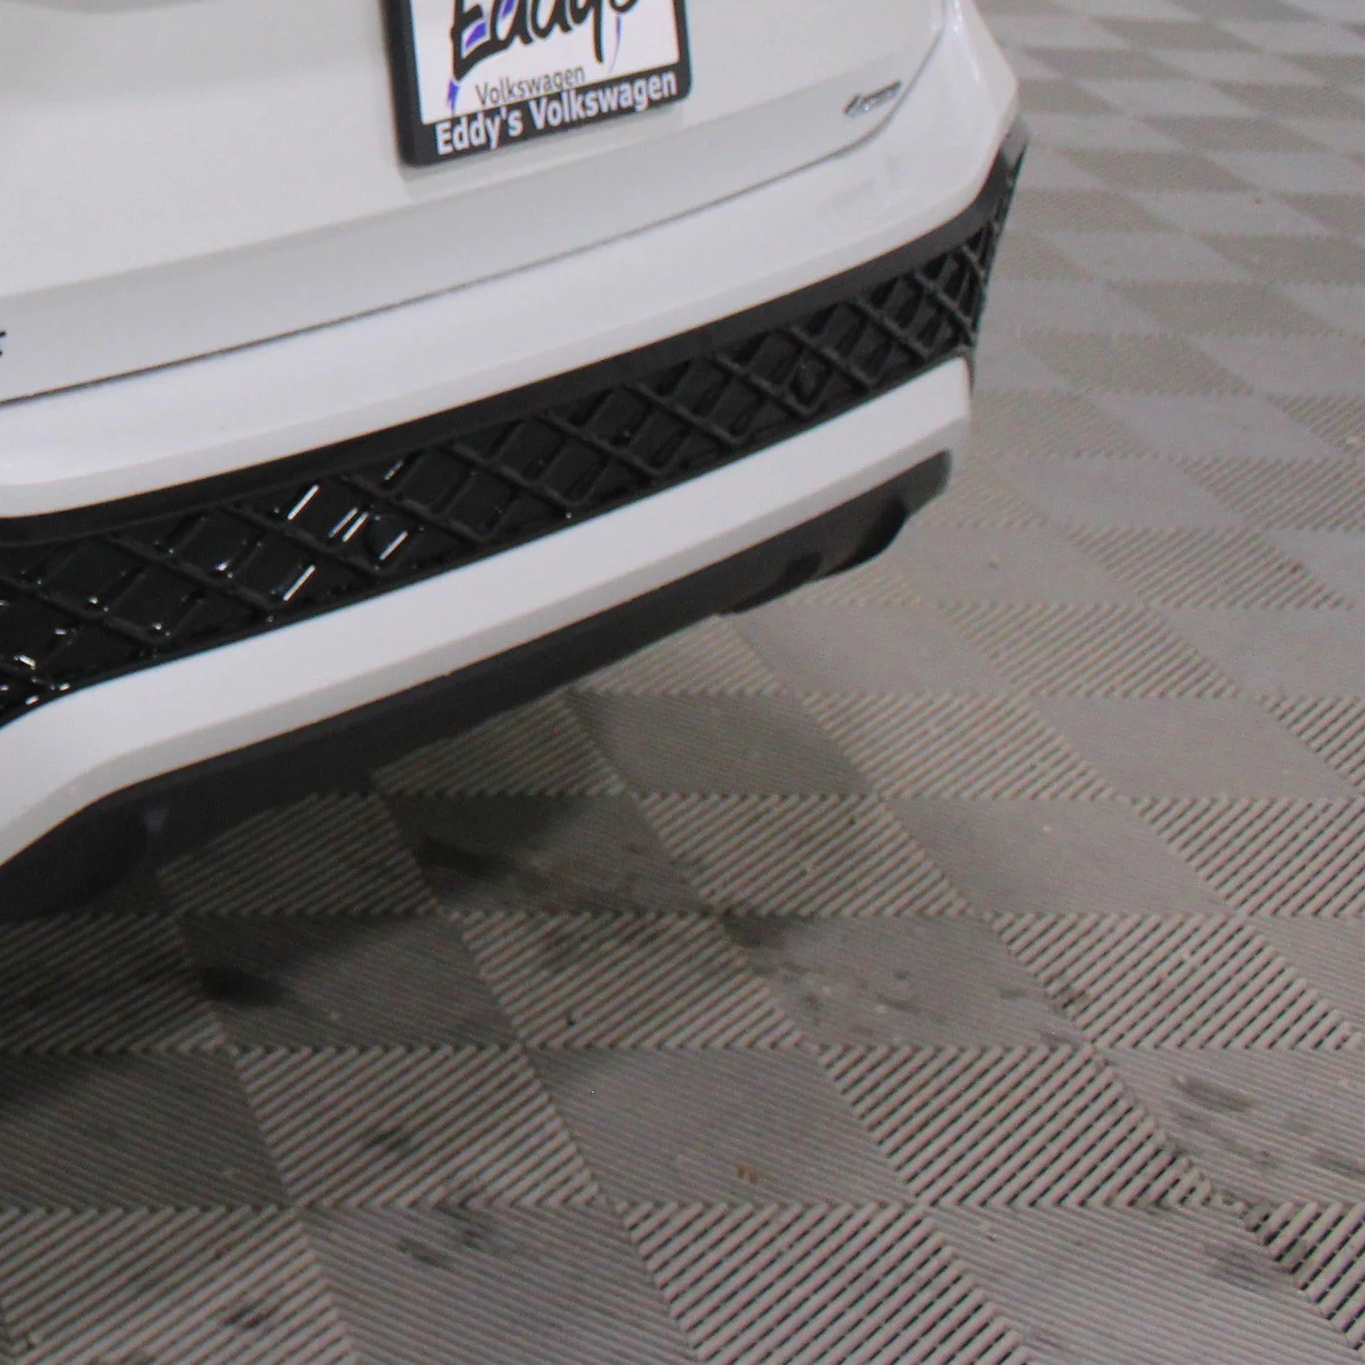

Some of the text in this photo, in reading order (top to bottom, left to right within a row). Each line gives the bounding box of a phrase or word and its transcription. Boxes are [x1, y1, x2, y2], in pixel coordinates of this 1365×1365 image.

[435, 71, 678, 156] Eddy's Volkswagen
[475, 65, 586, 106] Volkswagen
